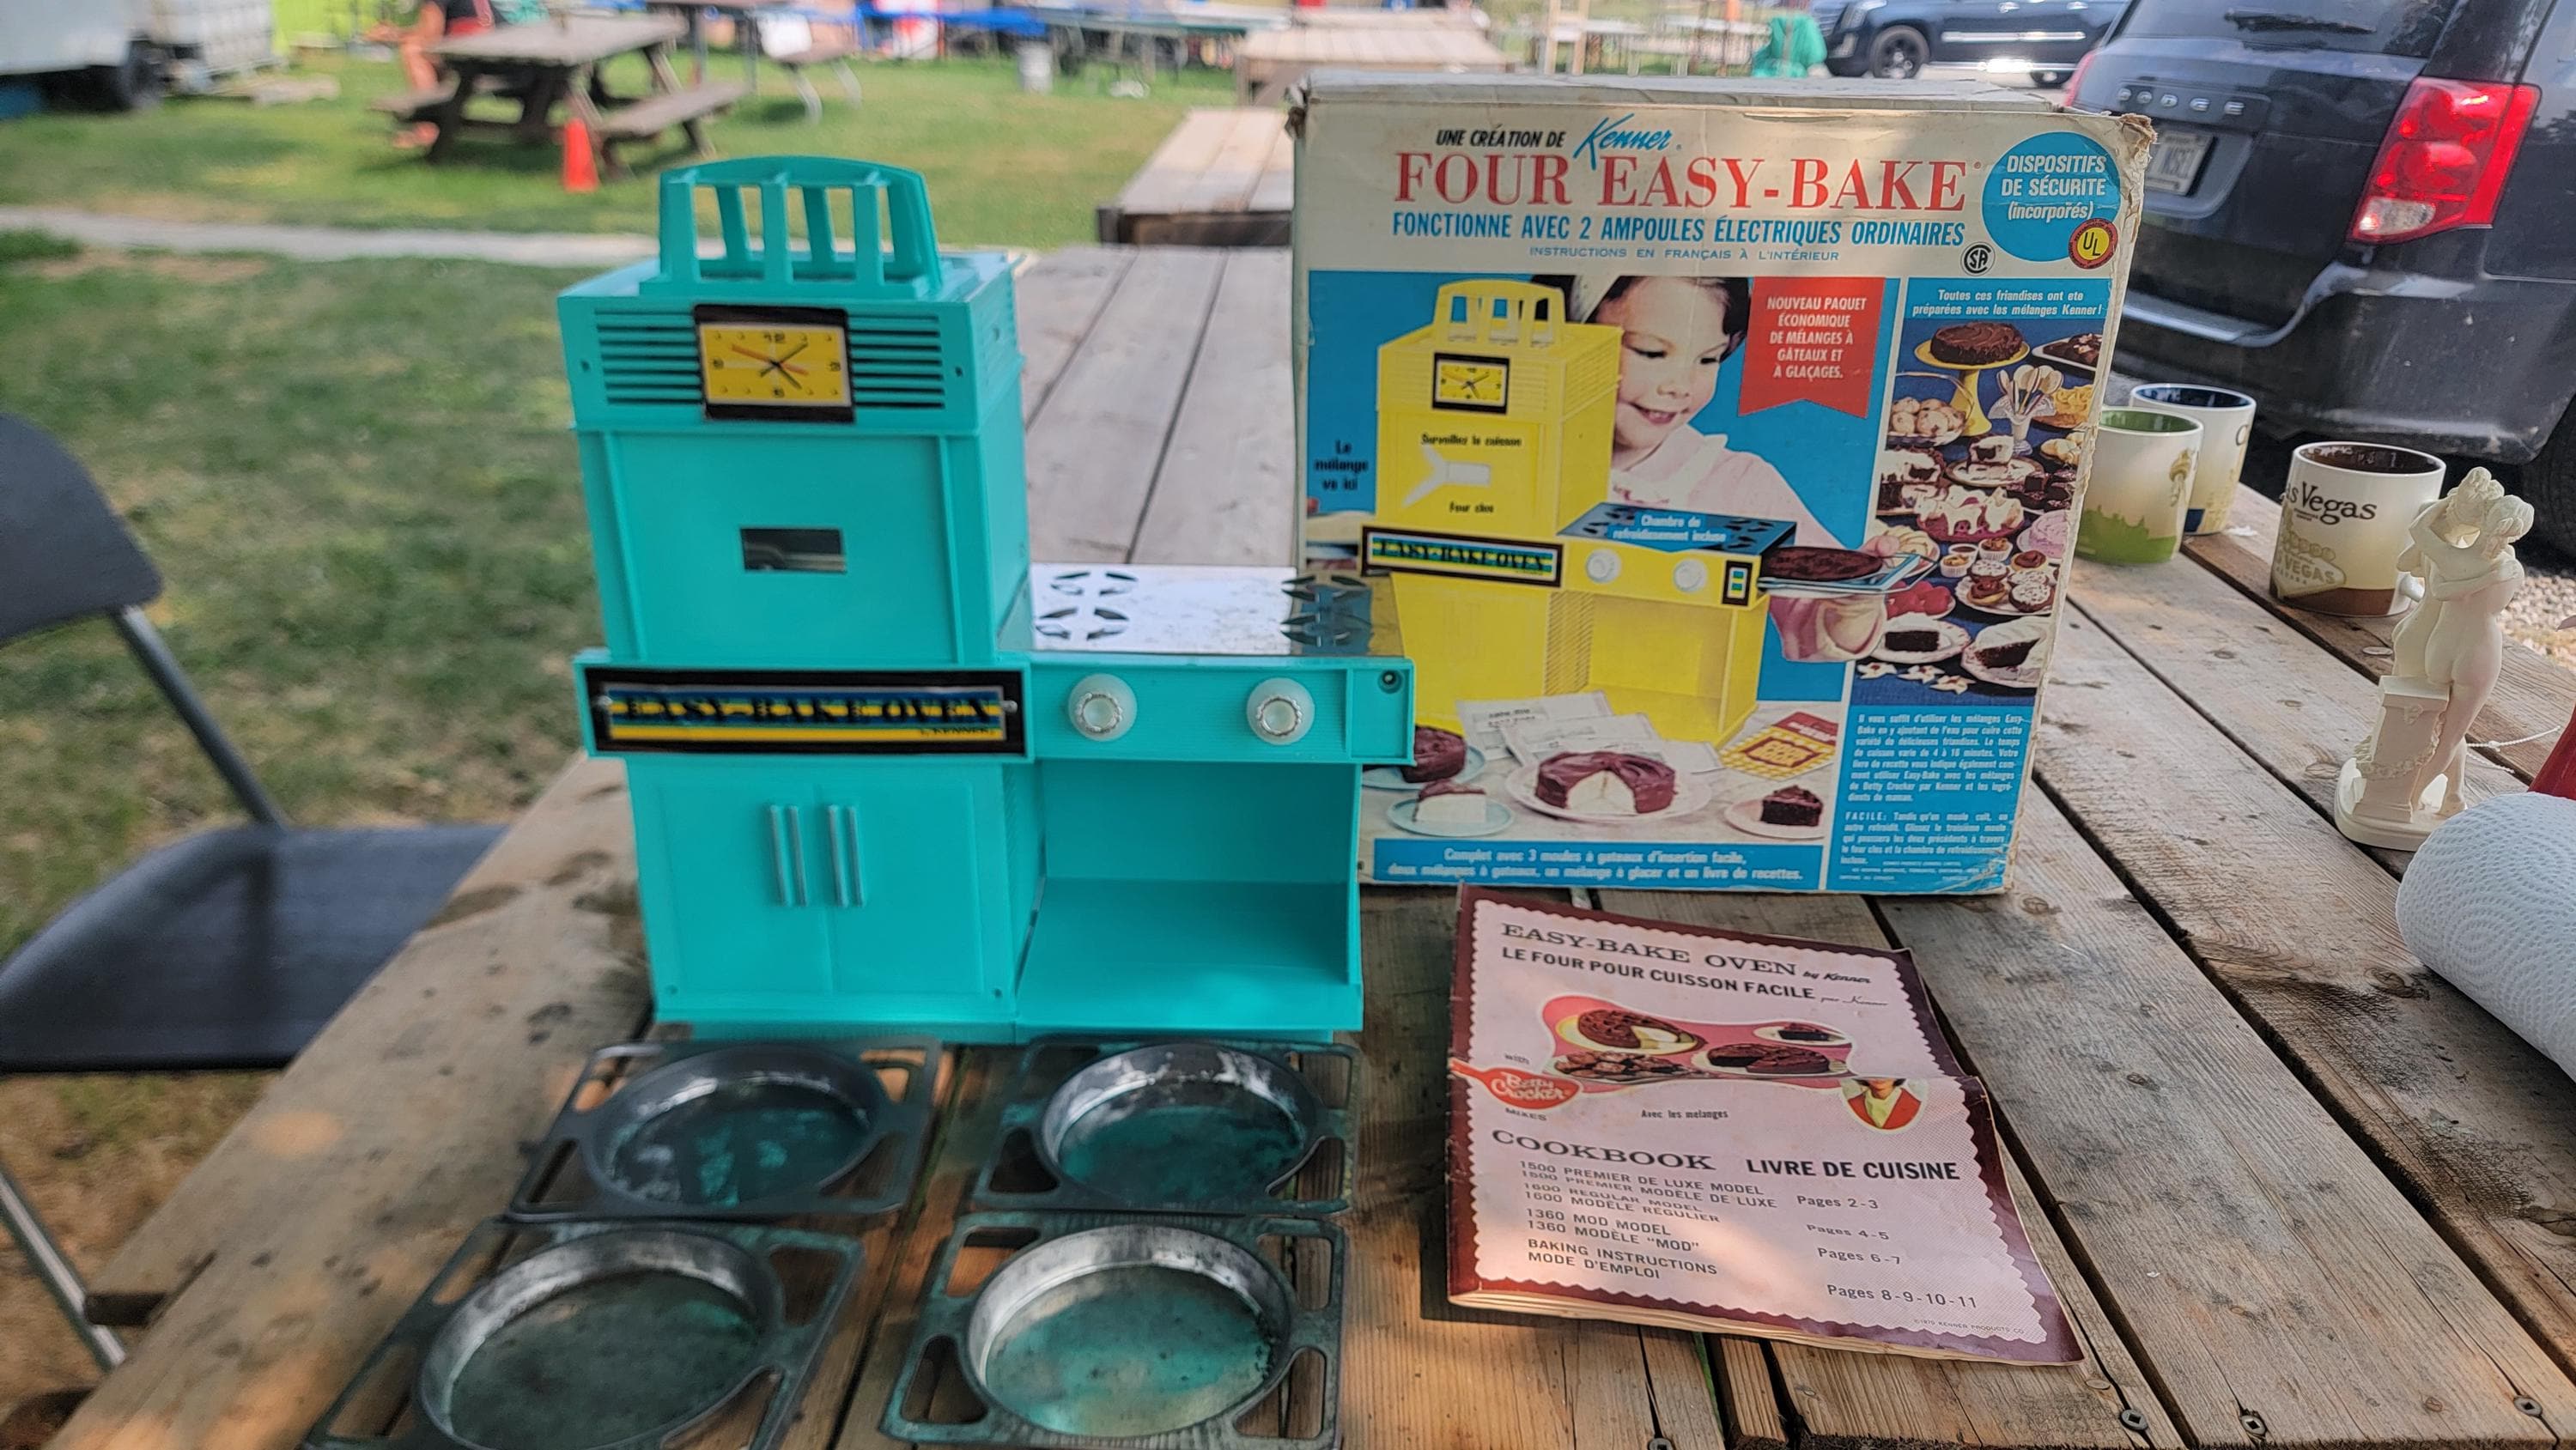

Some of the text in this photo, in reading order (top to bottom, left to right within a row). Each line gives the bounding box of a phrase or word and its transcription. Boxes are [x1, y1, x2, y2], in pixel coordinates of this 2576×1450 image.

[2117, 88, 2245, 116] DODGE
[1436, 112, 1674, 171] UNE CRÉATION DE Kenner
[2007, 155, 2107, 173] DISPOSITIFS
[1394, 152, 1966, 212] FOUR EASY-BAKE
[2001, 178, 2023, 197] DE
[2008, 200, 2093, 223] (incorporés)
[1392, 212, 1965, 246] FONCTIONNE AVEC 2 AMPOULES ÉLECTRIQUES ORDINAIRES
[2083, 232, 2101, 256] UL
[1529, 247, 1839, 261] INSTRUCTIONS EN FRANÇAIS À L'INTÉRIEUR
[1767, 296, 1867, 311] NOUVEAU PAQUET
[1938, 289, 1971, 300] Toutes
[1975, 292, 1992, 300] ces
[1996, 289, 2044, 300] friandises
[2047, 291, 2064, 300] ont
[1777, 311, 1850, 327] ÉCONOMIQUE
[1912, 303, 1962, 318] préparées
[1965, 306, 1990, 315] avec
[1993, 304, 2008, 315] les
[2012, 303, 2057, 318] mélanges
[1770, 329, 1853, 344] DE MÉLANGES À
[1777, 347, 1844, 361] GÂTEAUX ET
[1773, 363, 1844, 382] À GLAÇAGES.
[2302, 481, 2378, 525] Vegas
[1641, 515, 1701, 528] Chambre de
[2284, 554, 2336, 585] VEGAS
[625, 696, 990, 724] EASY-BAKE OVEN
[1443, 847, 1492, 864] Complet
[1496, 851, 1524, 862] avec
[1528, 848, 1537, 862] 3
[1388, 862, 1417, 876] deux
[1545, 867, 1560, 877] un
[1667, 867, 1680, 878] et
[1684, 869, 1699, 878] un
[1732, 867, 1747, 879] de
[1500, 922, 1872, 984] EASY-BAKE OVEN by Kenner
[1502, 946, 1527, 961] LE
[1531, 951, 1585, 969] FOUR
[1589, 961, 1644, 980] POUR
[1649, 968, 1739, 992] CUISSON
[1743, 981, 1816, 999] FACILE
[1490, 1077, 1566, 1101] Crocker
[1500, 1071, 1554, 1089] Betty
[1504, 1107, 1547, 1121] MIXES
[1641, 1108, 1663, 1119] Avec
[1668, 1109, 1683, 1119] les
[1492, 1129, 1717, 1171] COOKBOOK
[1520, 1160, 1765, 1195] 1500 PREMIER DE LUXE MODEL
[1746, 1158, 1961, 1180] LIVRE DE CUISINE
[1522, 1170, 1558, 1181] 1500
[1565, 1176, 1633, 1192] PREMIER
[1710, 1193, 1730, 1204] DE
[1736, 1196, 1778, 1209] LUXE
[1523, 1182, 1703, 1212] 1600 REGULAR MODEL
[1525, 1191, 1563, 1203] 1600
[1796, 1195, 1841, 1209] Pages
[1526, 1207, 1672, 1236] 1360 MOD MODEL
[1527, 1219, 1566, 1233] 1360
[1806, 1223, 1852, 1236] Pages
[1528, 1238, 1718, 1276] BAKING INSTRUCTIONS
[1817, 1247, 1864, 1262] Pages
[1528, 1251, 1661, 1279] MODE D'EMPLOI
[1826, 1284, 1874, 1300] Pages
